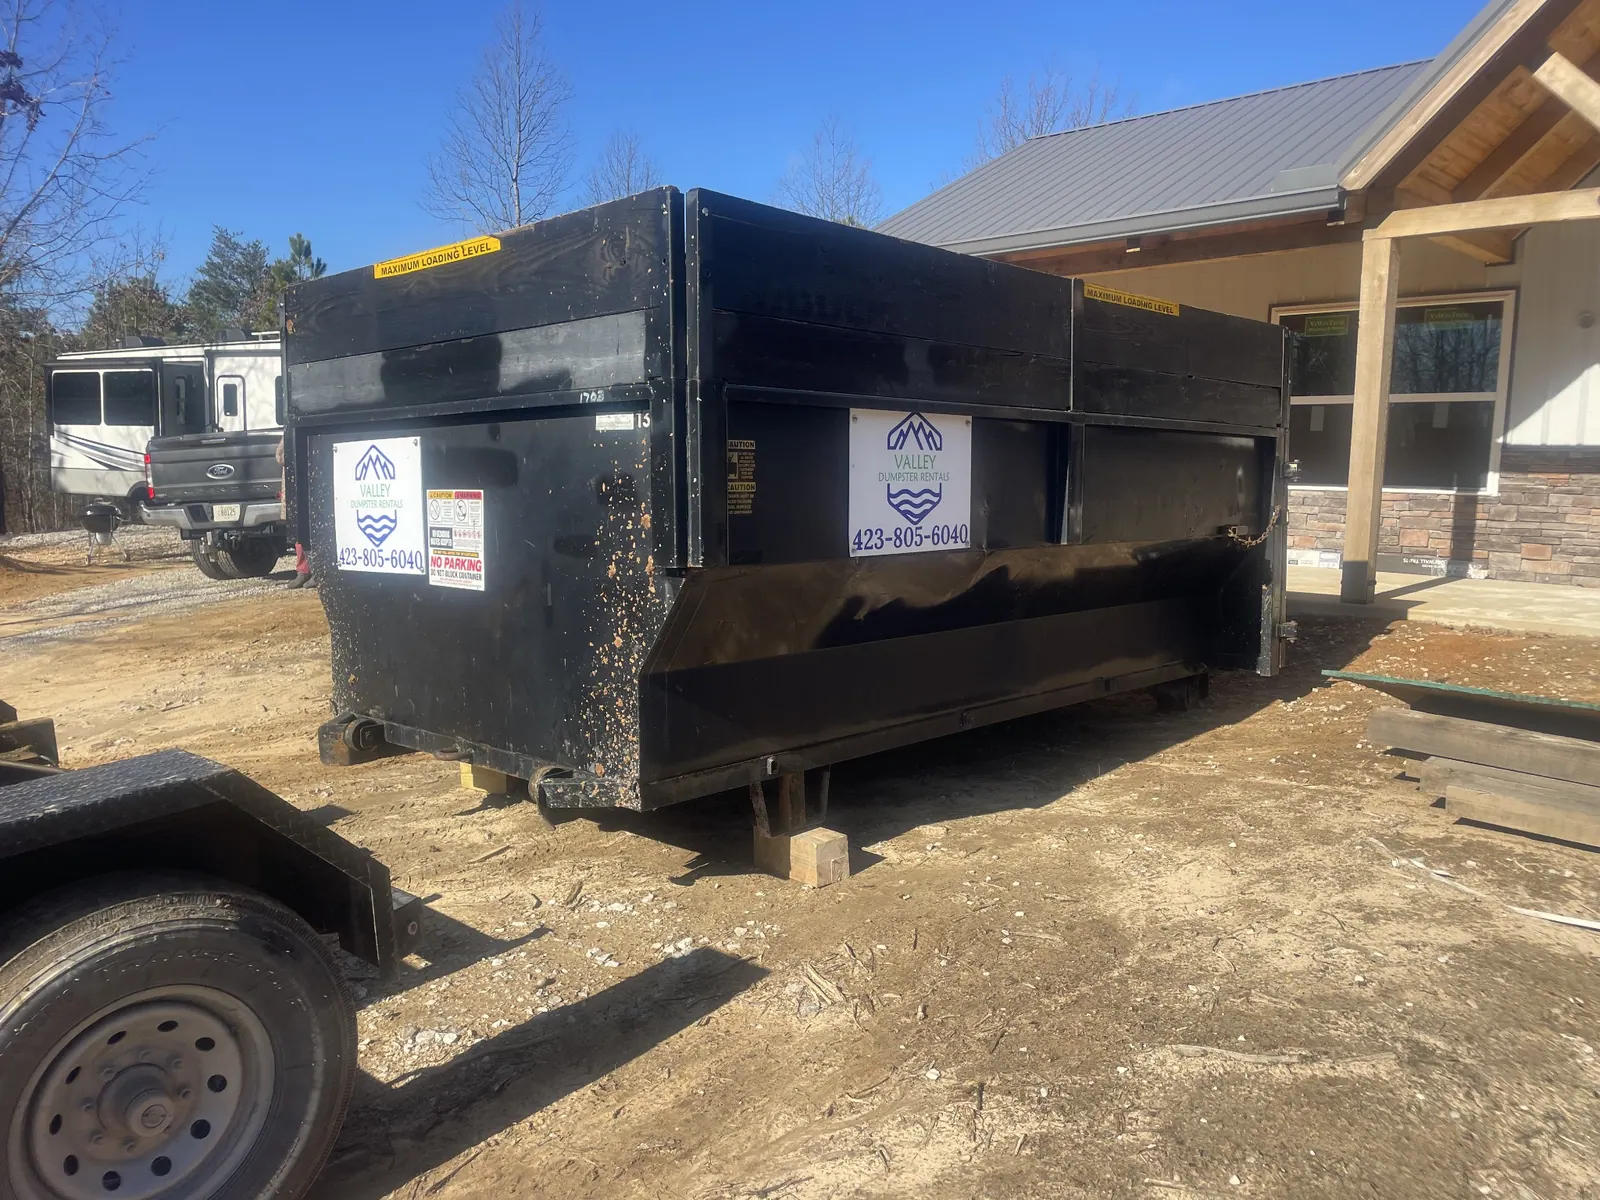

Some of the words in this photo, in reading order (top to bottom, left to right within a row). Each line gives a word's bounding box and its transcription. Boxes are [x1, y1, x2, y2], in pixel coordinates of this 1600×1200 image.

[381, 260, 420, 275] MAXIMUM
[422, 251, 460, 266] LOADING
[462, 243, 491, 256] LEVEL
[1087, 289, 1121, 302] MAXIMUM
[1123, 296, 1153, 309] LOADING
[1154, 303, 1174, 314] LEVEL
[894, 454, 937, 470] VALLEY
[214, 466, 228, 475] Ford
[878, 472, 918, 482] DUMPSTER
[920, 472, 950, 482] RENTALS
[360, 484, 391, 498] VALLEY
[432, 491, 453, 499] CAUTION
[351, 499, 378, 509] DUMPSTER
[379, 499, 403, 509] RENTALS
[852, 524, 968, 551] 423-805-6040
[339, 547, 423, 570] 423-805-6040
[431, 556, 442, 568] NO
[444, 557, 482, 572] PARKING
[445, 570, 458, 578] BLOCK
[459, 571, 482, 581] CONTAINER
